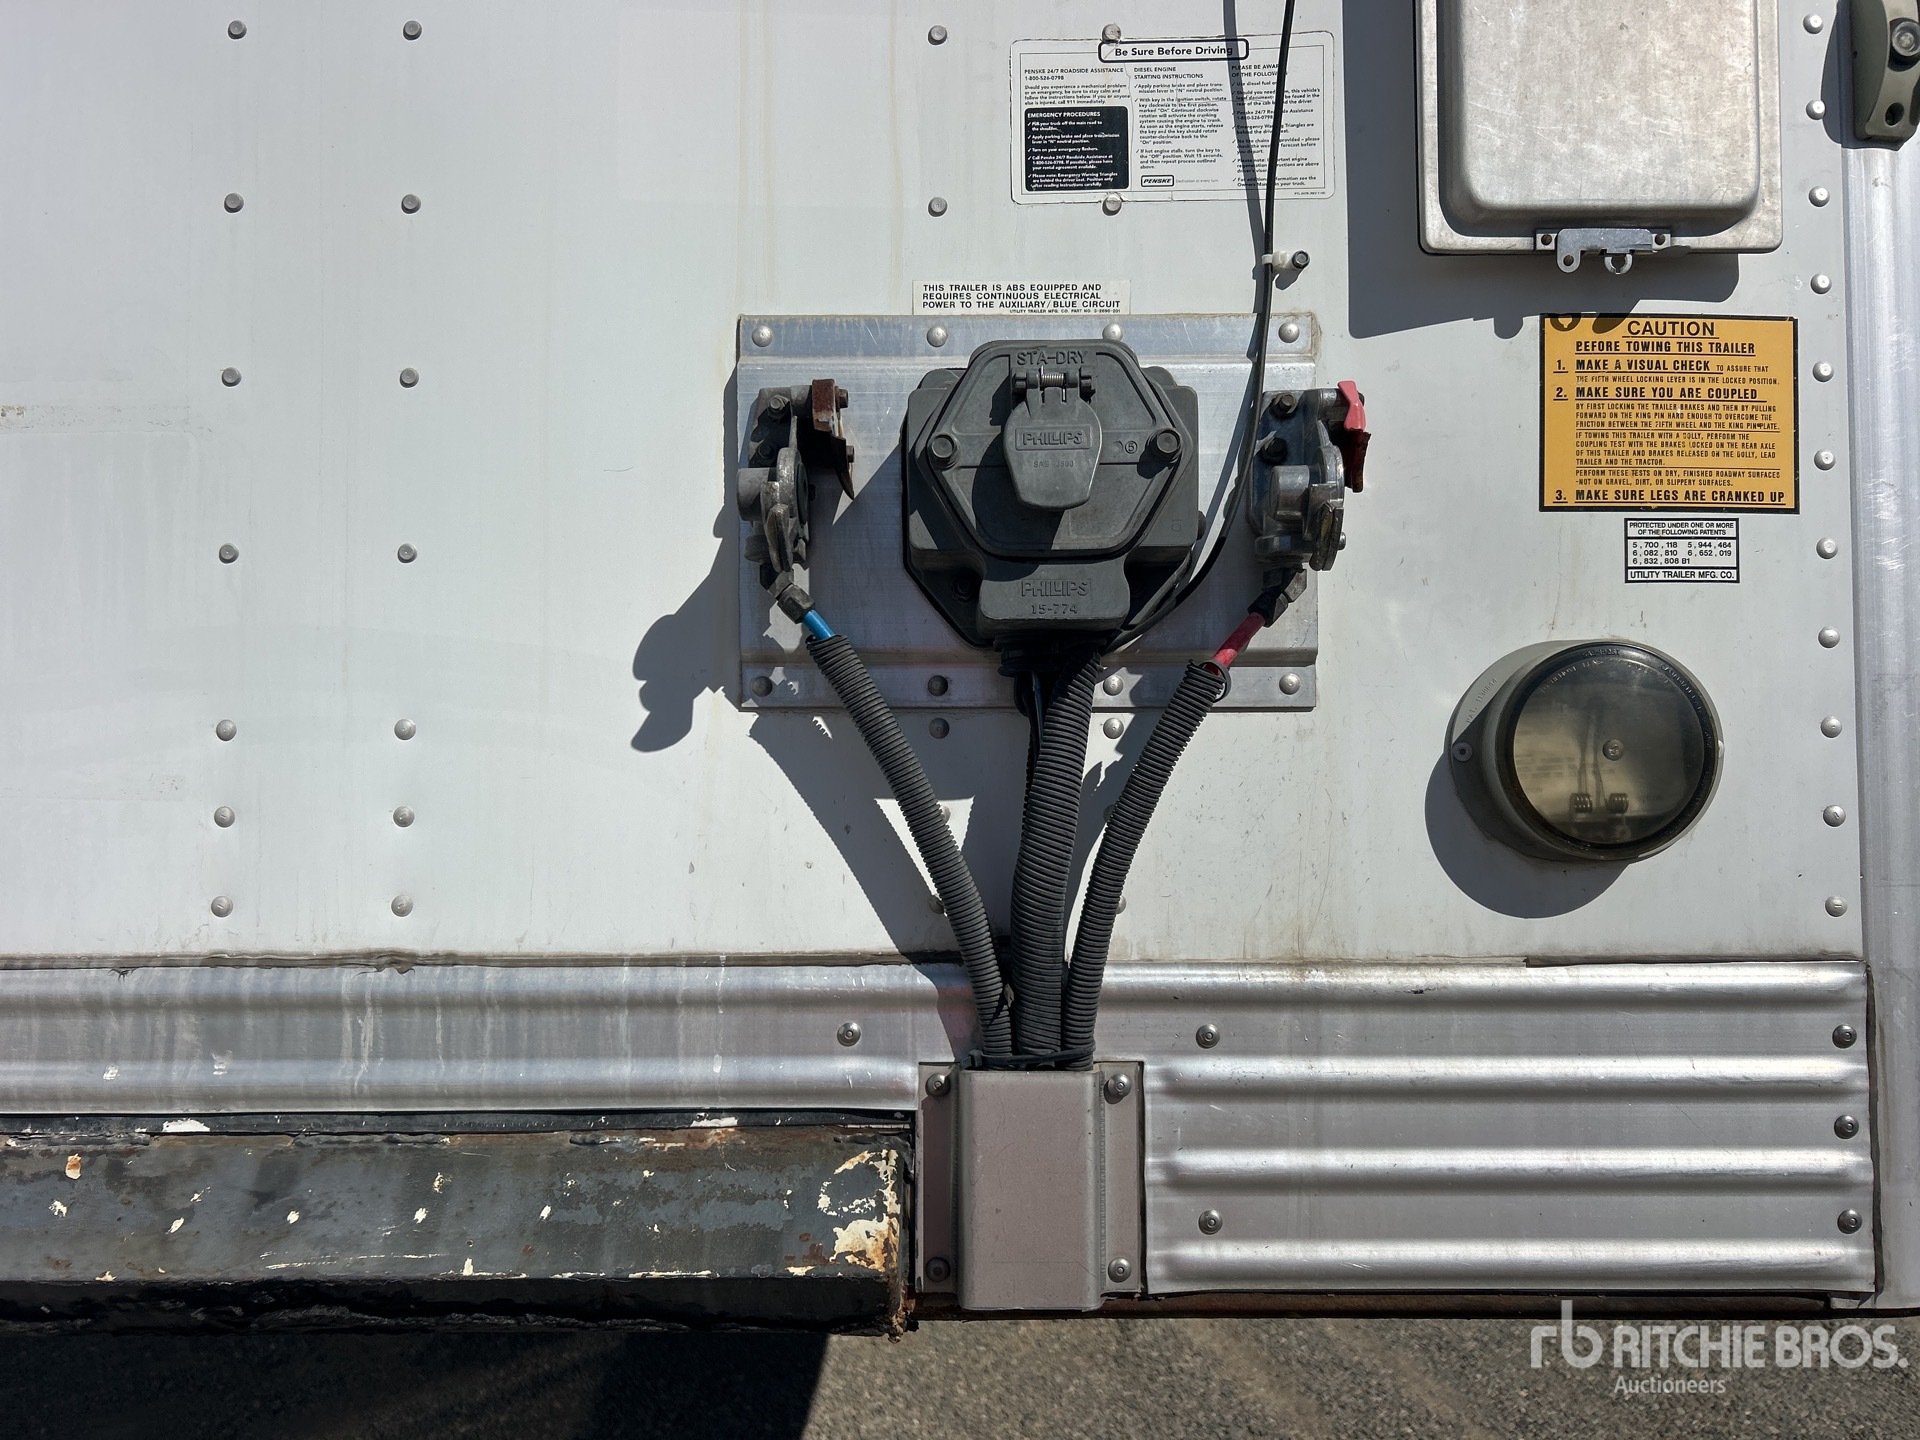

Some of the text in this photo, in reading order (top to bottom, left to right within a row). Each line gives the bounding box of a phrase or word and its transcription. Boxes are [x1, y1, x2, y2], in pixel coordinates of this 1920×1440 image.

[1115, 46, 1233, 56] Be Sure Before Driving
[992, 283, 1001, 291] IS
[1006, 283, 1025, 291] ABS
[1029, 283, 1077, 291] EQUIPPED
[1081, 283, 1101, 291] AND
[959, 300, 972, 308] TO
[976, 300, 994, 308] THE
[1627, 320, 1714, 336] CAUTION
[1575, 341, 1754, 353] BEFORE TOWING THIS TRAILER
[1016, 351, 1088, 365] STA-DRY
[1556, 359, 1565, 370] 1.
[1575, 359, 1608, 370] MAKE
[1614, 359, 1621, 370] A
[1626, 359, 1668, 370] VISUAL
[1672, 360, 1710, 371] CHECK
[1726, 364, 1751, 372] ASSURE
[1555, 386, 1757, 399] 2. MAKE SURE YOU ARE COUPLED
[1022, 431, 1084, 446] PHILLIPS
[1555, 489, 1784, 502] 3. MAKE SURE LEGS ARE CRANKED UP
[1630, 570, 1660, 578] UTILITY
[1661, 570, 1695, 578] TRAILER
[1698, 570, 1718, 578] MFG.
[1021, 580, 1089, 597] PHILLIPS
[1031, 603, 1078, 615] 15-774
